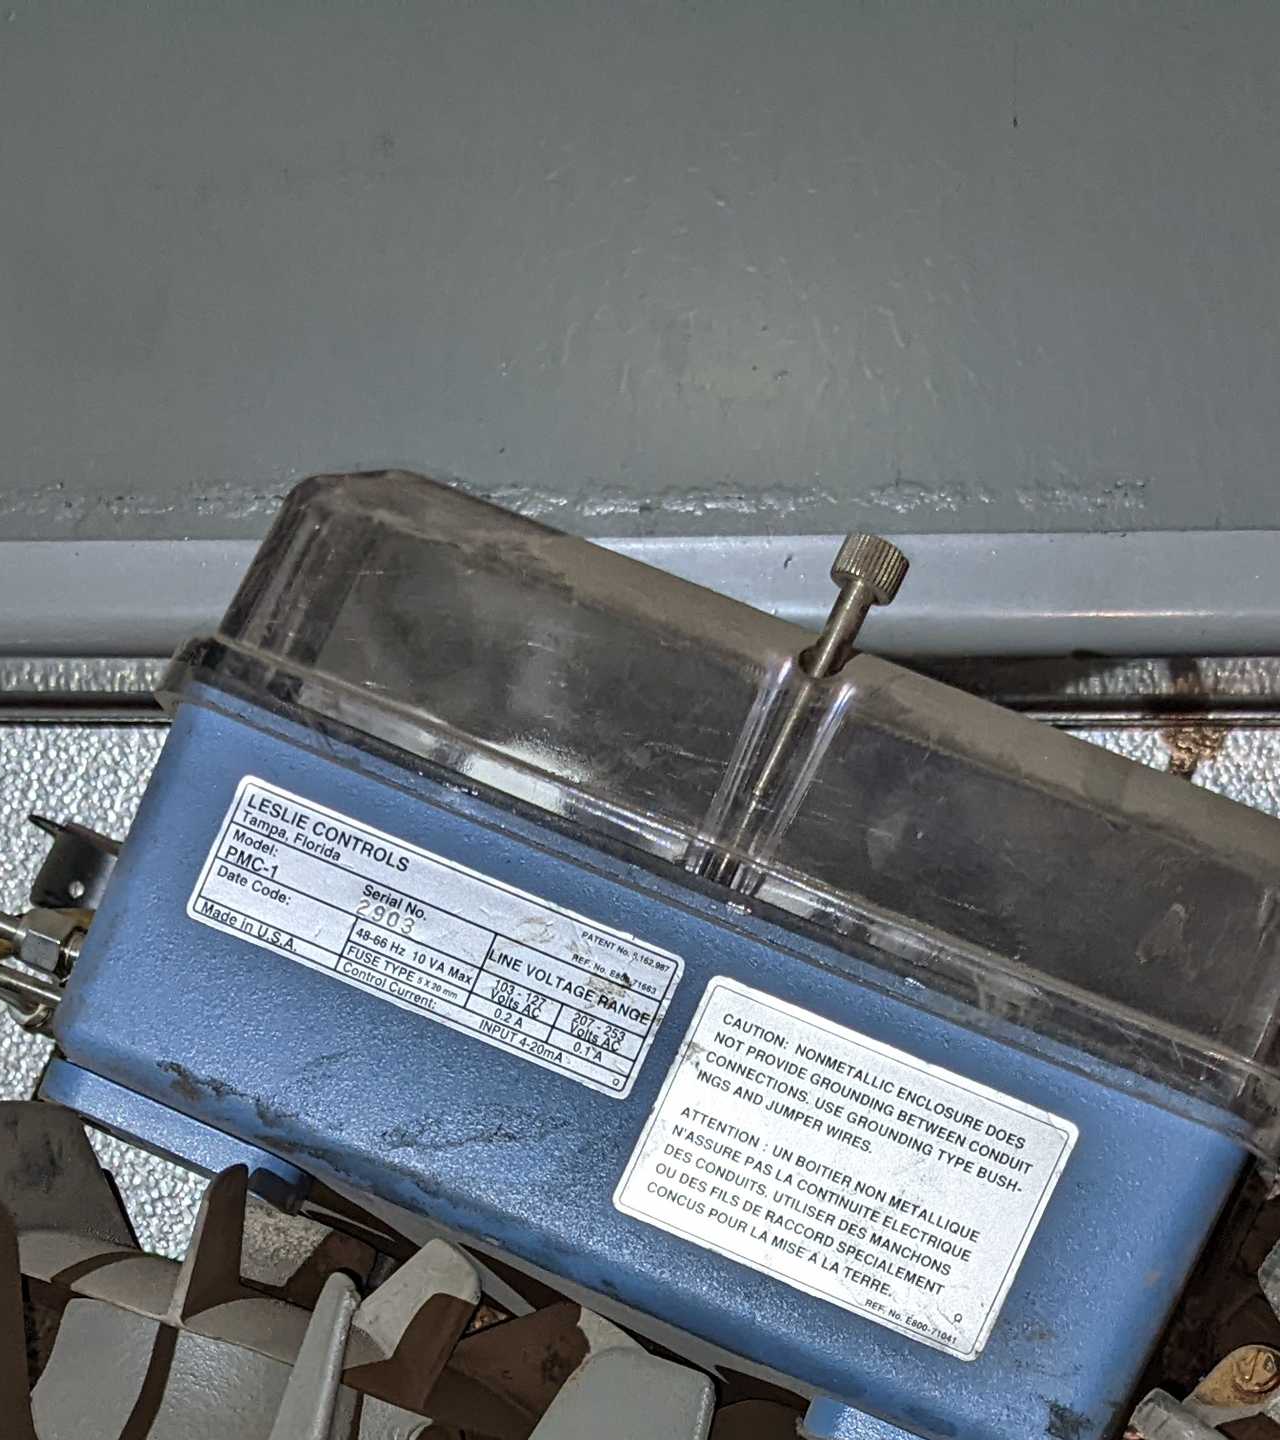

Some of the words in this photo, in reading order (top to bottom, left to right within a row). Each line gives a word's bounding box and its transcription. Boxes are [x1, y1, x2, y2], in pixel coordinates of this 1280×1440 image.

[232, 828, 279, 858] Model:
[242, 809, 289, 842] Tampa,
[293, 831, 342, 862] Florida
[247, 793, 310, 831] LESLIE
[312, 821, 410, 872] CONTROLS
[216, 864, 249, 887] Date
[251, 879, 292, 906] Code:
[224, 844, 279, 880] PMC-1
[362, 884, 404, 910] Serial
[404, 901, 427, 921] No.
[198, 901, 238, 928] Made
[238, 917, 254, 935] in
[254, 924, 298, 954] U.S.A.
[581, 930, 617, 950] PATENT
[616, 945, 630, 957] No.
[346, 945, 380, 967] FUSE
[383, 959, 417, 983] TYPE
[355, 927, 389, 949] 48-66
[389, 941, 406, 957] Hz
[411, 950, 427, 966] 10
[429, 957, 446, 975] VA
[447, 965, 473, 985] Max
[342, 961, 388, 989] Control
[388, 981, 437, 1010] Current:
[487, 948, 524, 973] LINE
[526, 963, 597, 1003] VOLTAGE
[596, 993, 651, 1026] RANGE
[487, 988, 520, 1012] Volts
[519, 1003, 542, 1021] AC
[492, 979, 516, 997] 103
[525, 992, 547, 1010] 127
[478, 1019, 519, 1043] INPUT
[518, 1037, 563, 1064] 4-20mA
[493, 1007, 513, 1024] 0.2
[513, 1016, 523, 1029] A
[566, 1022, 600, 1046] Volts
[599, 1037, 621, 1055] AC
[571, 1011, 596, 1030] 207
[603, 1025, 626, 1044] 253
[572, 1041, 591, 1057] 0.1
[592, 1048, 602, 1063] A
[713, 1031, 745, 1052] NOT
[745, 1045, 809, 1080] PROVIDE
[809, 1072, 895, 1117] GROUNDING
[896, 1109, 967, 1148] BETWEEN
[968, 1140, 1034, 1175] CONDUIT
[722, 1013, 789, 1050] CAUTION:
[794, 1043, 895, 1094] NONMETALLIC
[896, 1086, 984, 1132] ENCLOSURE
[984, 1123, 1026, 1150] DOES
[696, 1069, 732, 1092] INGS
[732, 1085, 764, 1106] AND
[765, 1100, 824, 1132] JUMPER
[826, 1124, 872, 1154] WIRES.
[705, 1051, 809, 1105] CONNECTIONS.
[814, 1096, 845, 1119] USE
[846, 1111, 934, 1157] GROUNDING
[937, 1148, 975, 1174] TYPE
[975, 1165, 1022, 1193] BUSH-
[671, 1124, 743, 1163] N'ASSURE
[743, 1155, 774, 1176] PAS
[774, 1168, 793, 1186] LA
[796, 1178, 881, 1223] CONTINUITE
[881, 1214, 972, 1263] ELECTRIQUE
[680, 1106, 761, 1148] ATTENTION
[772, 1144, 794, 1163] UN
[794, 1155, 853, 1189] BOITIER
[853, 1180, 887, 1203] NON
[887, 1195, 981, 1244] METALLIQUE
[655, 1162, 677, 1179] OU
[678, 1172, 708, 1193] DES
[709, 1185, 741, 1207] FILS
[741, 1199, 763, 1217] DE
[764, 1209, 835, 1248] RACCORD
[835, 1240, 946, 1295] SPECIALEMENT
[663, 1143, 693, 1164] DES
[695, 1157, 768, 1198] CONDUITS.
[772, 1190, 836, 1227] UTILISER
[837, 1218, 868, 1240] DES
[869, 1232, 952, 1276] MANCHONS
[647, 1181, 706, 1215] CONCUS
[707, 1207, 749, 1233] POUR
[749, 1226, 768, 1243] LA
[770, 1235, 807, 1259] MISE
[807, 1252, 818, 1265] A
[820, 1256, 840, 1275] LA
[844, 1265, 892, 1297] TERRE.
[864, 1298, 885, 1312] REF.
[888, 1308, 901, 1320] No.
